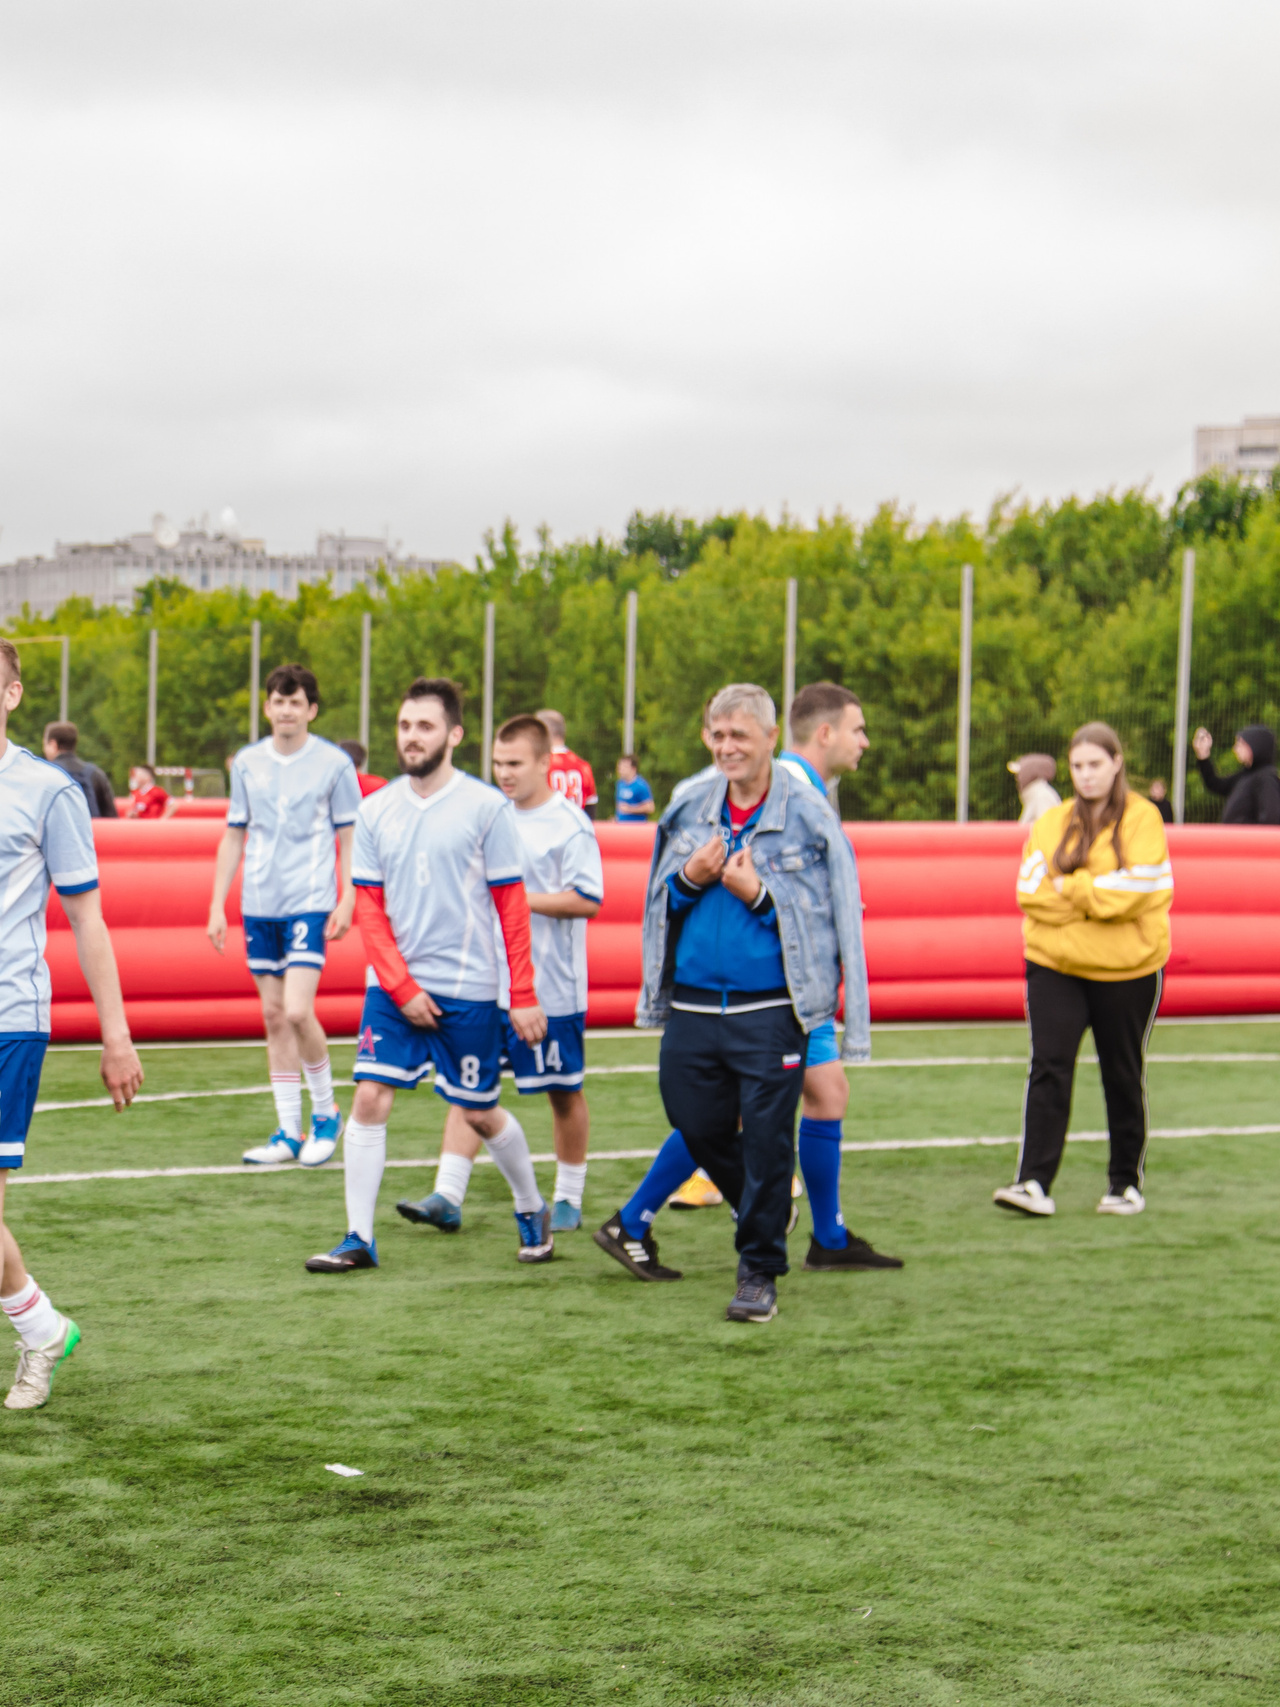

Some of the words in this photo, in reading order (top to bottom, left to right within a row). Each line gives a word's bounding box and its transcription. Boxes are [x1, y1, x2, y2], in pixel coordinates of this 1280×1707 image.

[292, 920, 309, 950] 2
[460, 1054, 480, 1089] 8
[532, 1040, 562, 1074] 14
